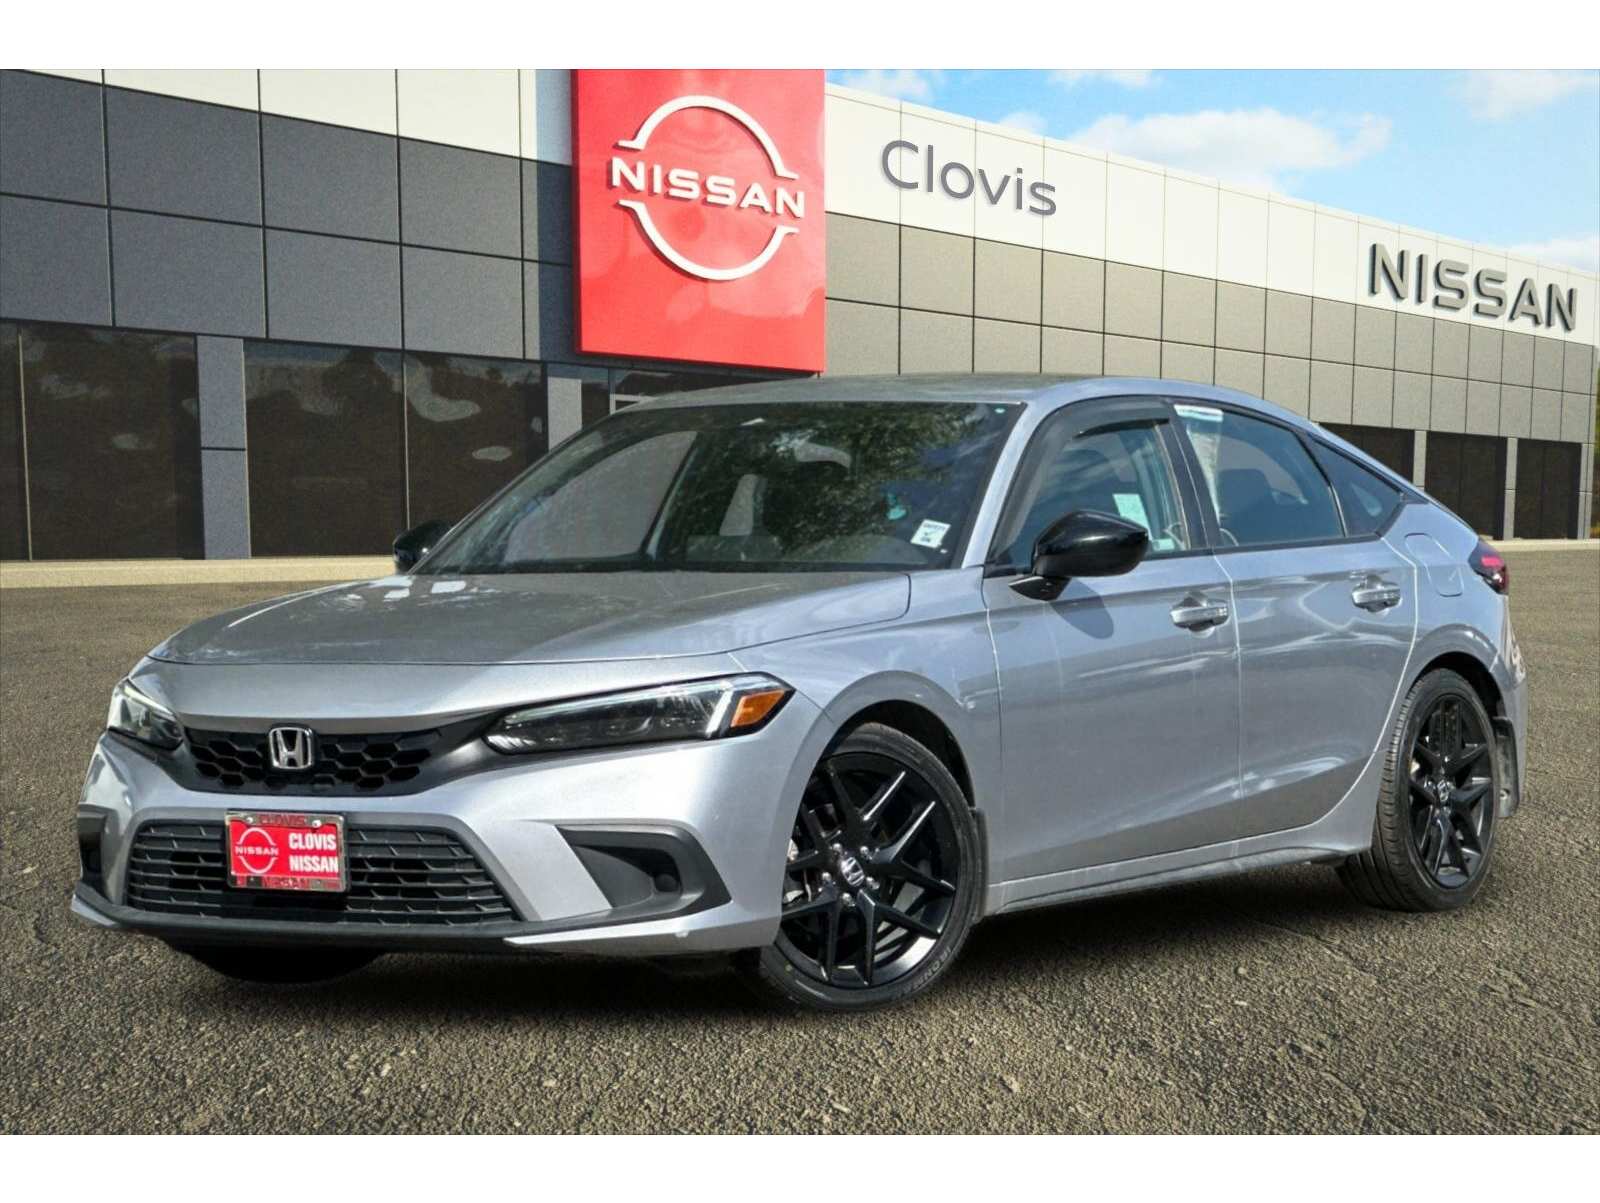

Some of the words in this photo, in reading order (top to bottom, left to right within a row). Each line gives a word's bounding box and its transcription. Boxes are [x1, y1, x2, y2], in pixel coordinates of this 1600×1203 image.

[610, 156, 805, 219] NISSAN
[881, 139, 1058, 217] Clovis
[1369, 242, 1578, 332] NISSAN
[235, 846, 279, 856] NISSAN
[288, 832, 337, 850] CLOVIS
[288, 855, 339, 873] NISSAN
